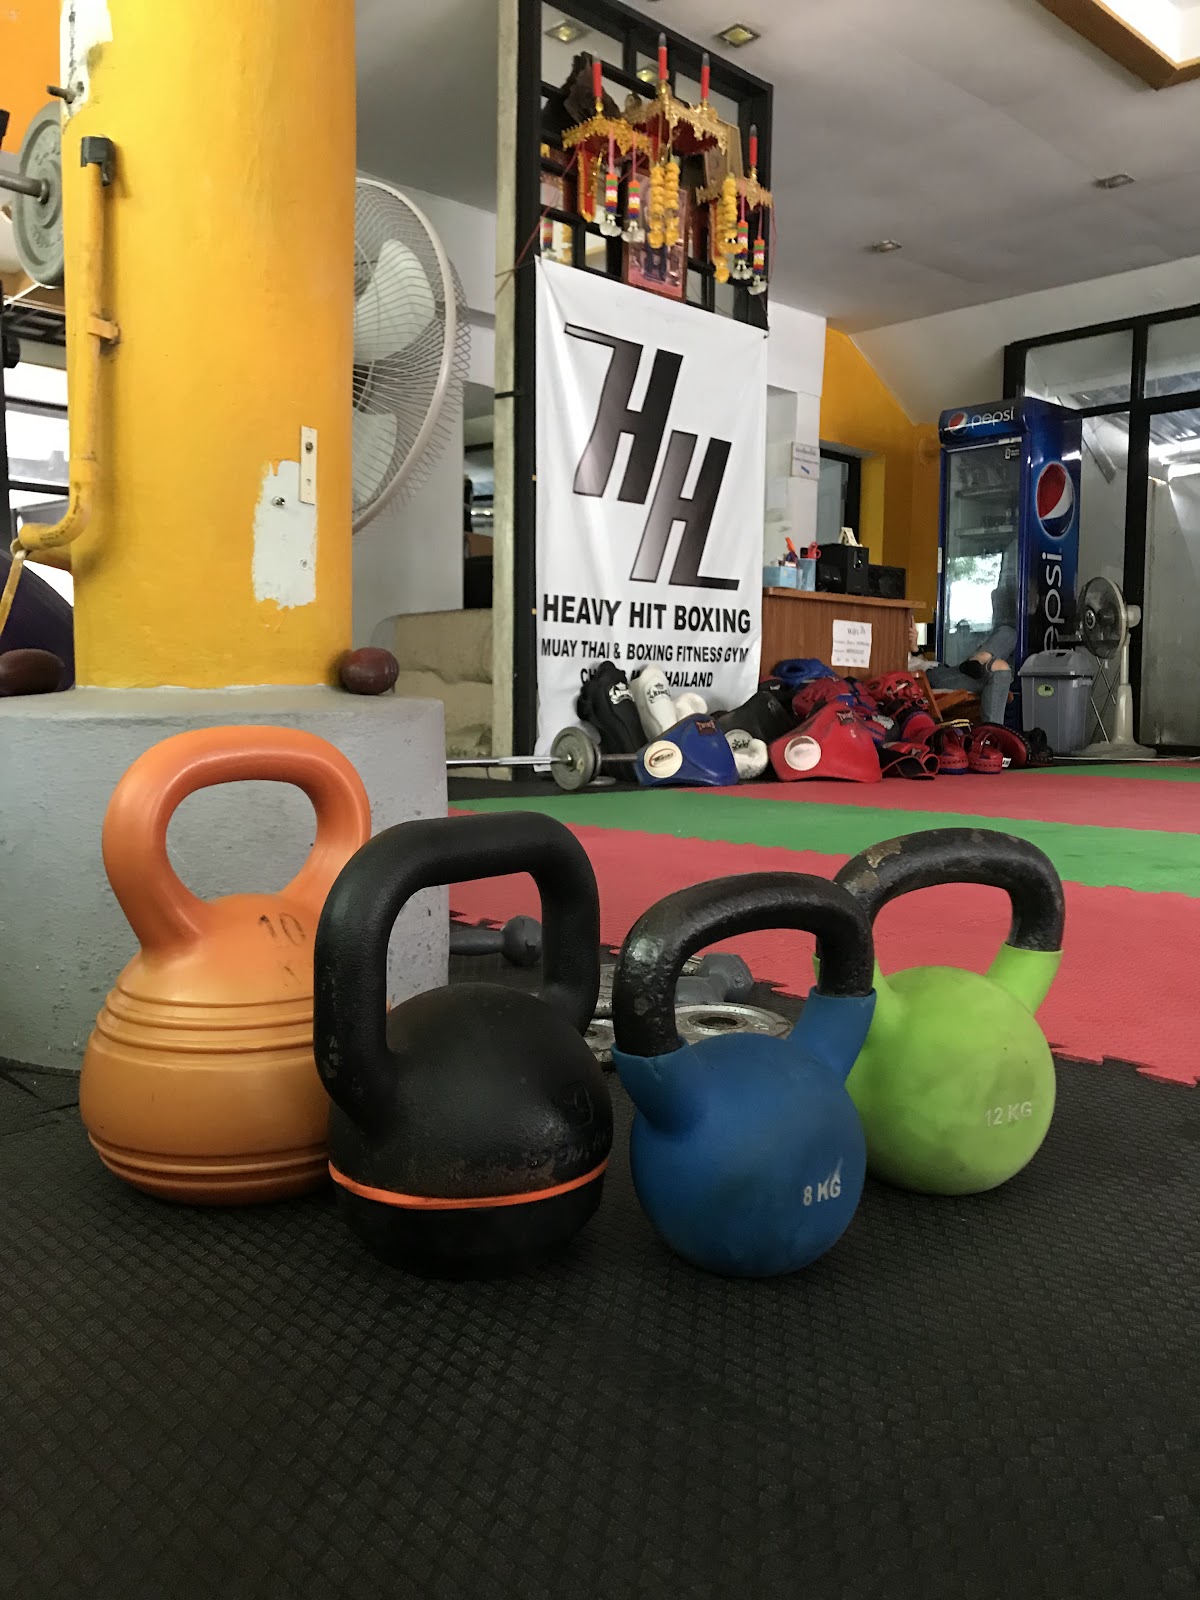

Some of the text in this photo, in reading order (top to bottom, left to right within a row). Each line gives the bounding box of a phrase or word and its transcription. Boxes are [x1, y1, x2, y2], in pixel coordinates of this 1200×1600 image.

[971, 406, 1014, 429] pepsi
[543, 593, 751, 634] HEAVY HIT BOXING
[1042, 551, 1065, 651] epsi
[541, 638, 750, 664] MUAY THAI & BOXING FITNESS GYM
[663, 671, 714, 688] HAILAND
[984, 1101, 1033, 1127] 12 KG
[802, 1175, 842, 1206] 8 KG
